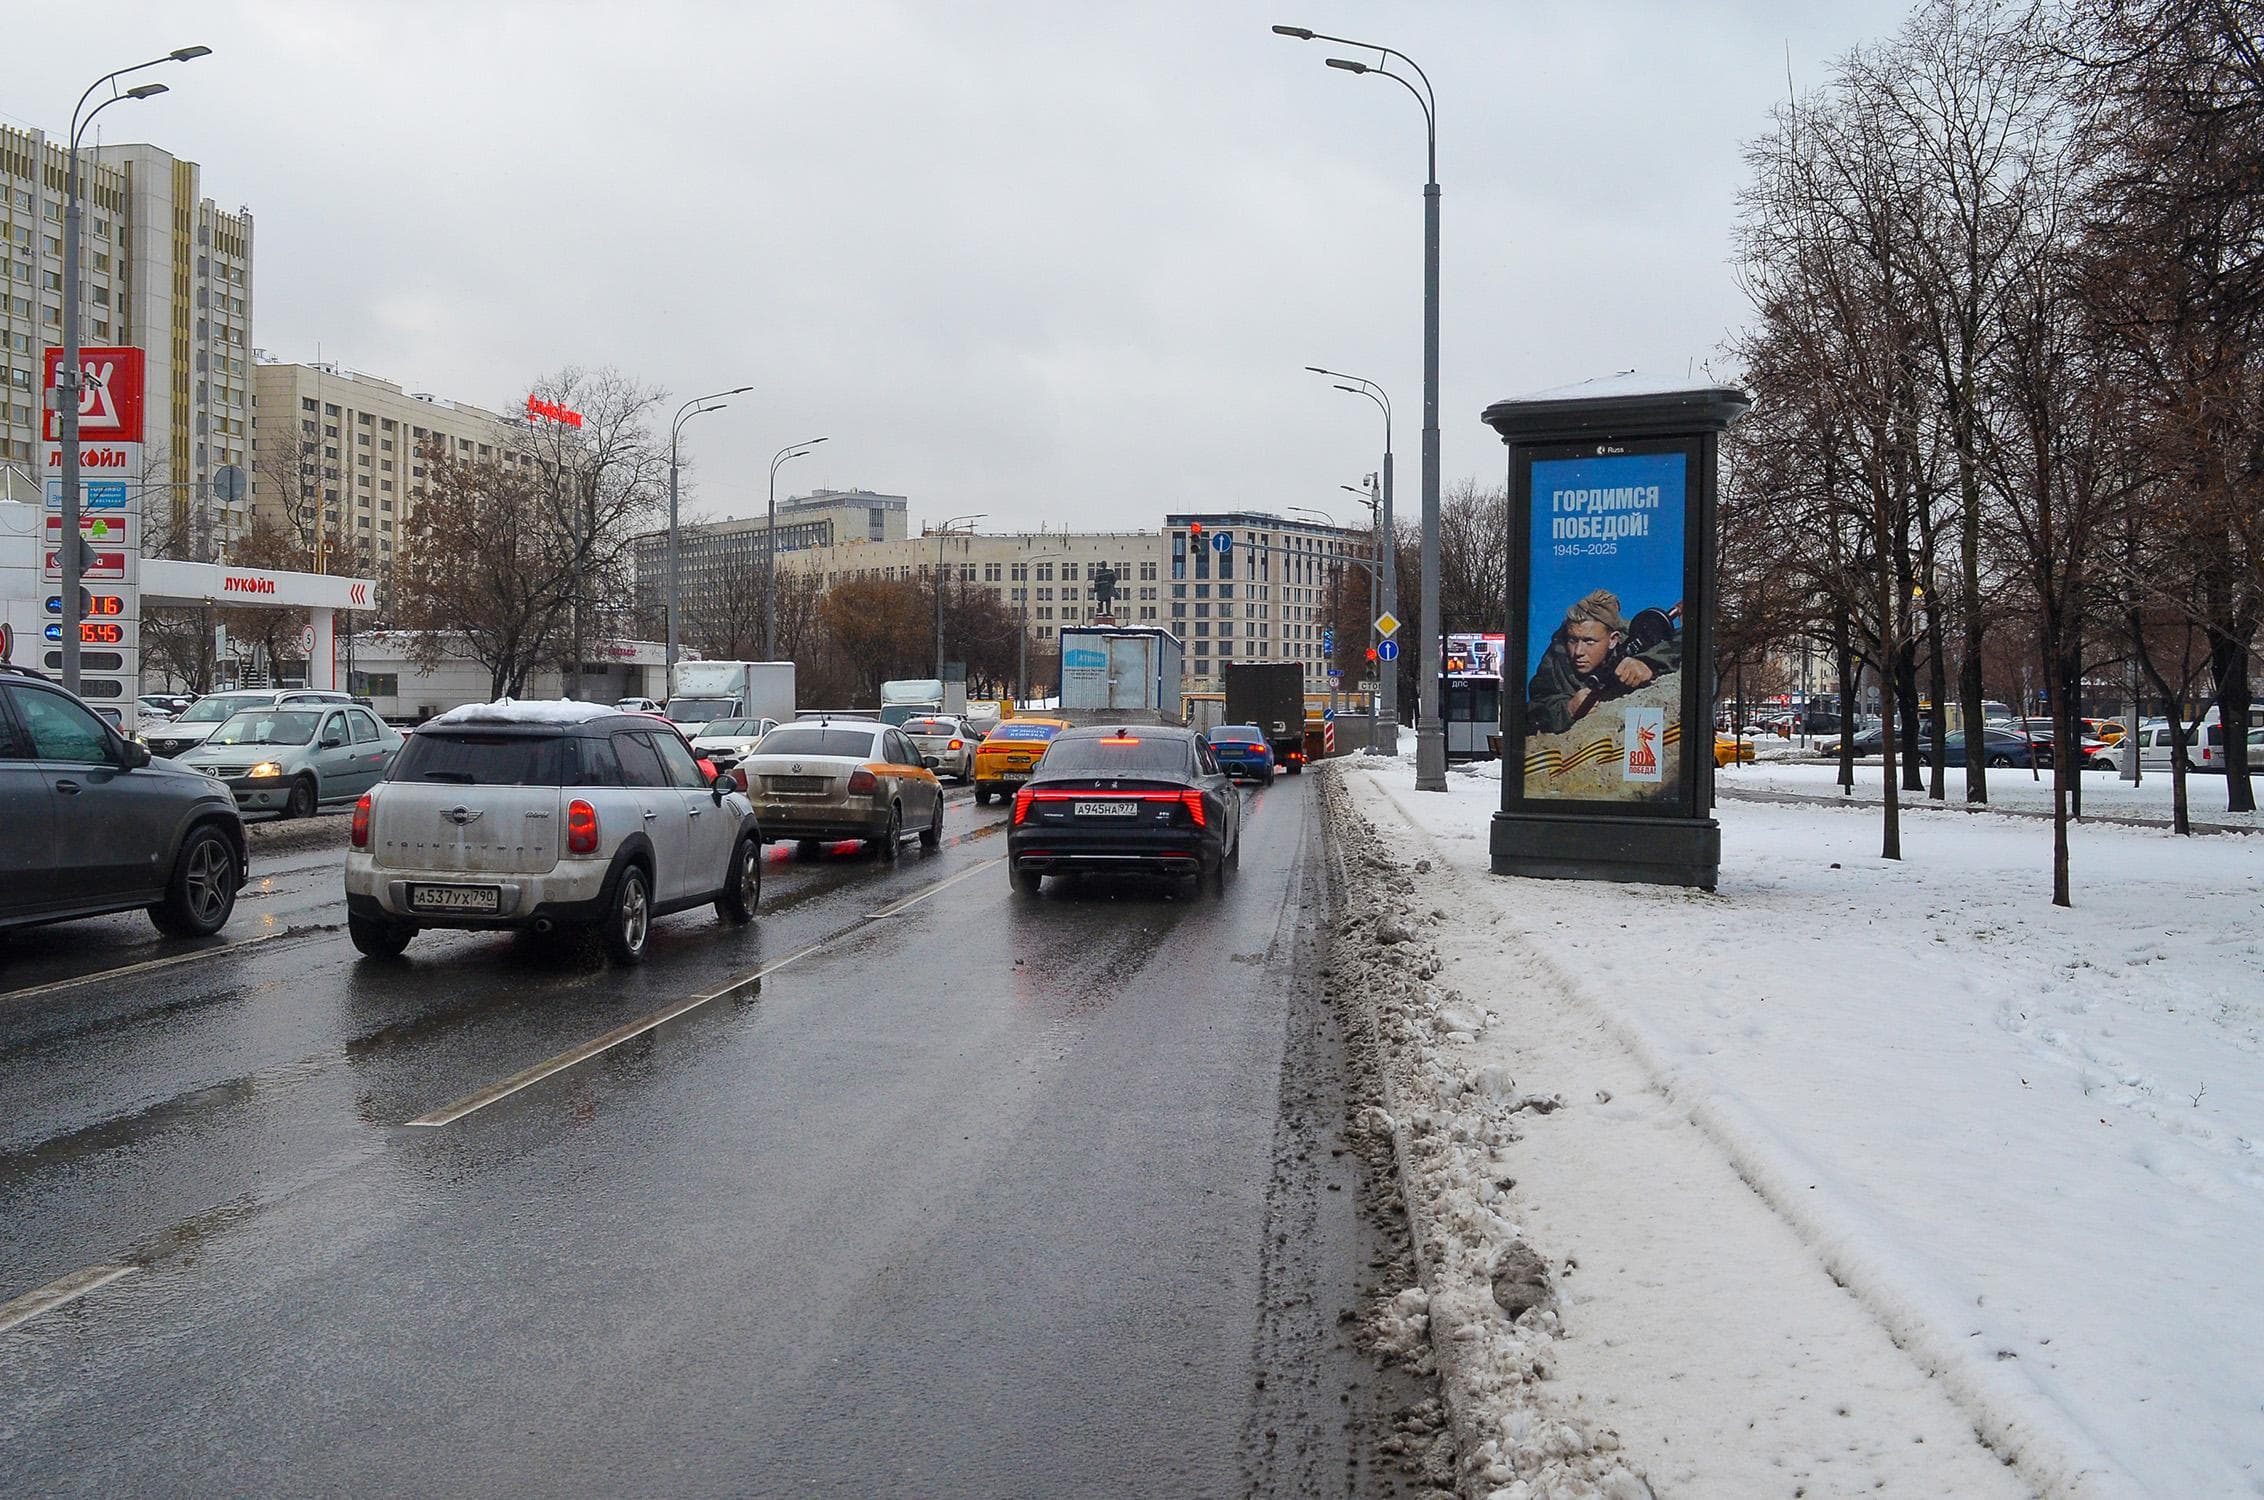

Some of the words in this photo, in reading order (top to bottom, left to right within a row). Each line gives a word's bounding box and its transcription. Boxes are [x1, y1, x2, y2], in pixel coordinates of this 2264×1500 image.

[1553, 486, 1659, 514] ГОРДИМСЯ
[1552, 512, 1649, 541] ПОБЕДОЙ!
[1452, 680, 1469, 688] ДПС
[1629, 750, 1644, 765] 80
[1628, 766, 1657, 775] ПОБЕДА!
